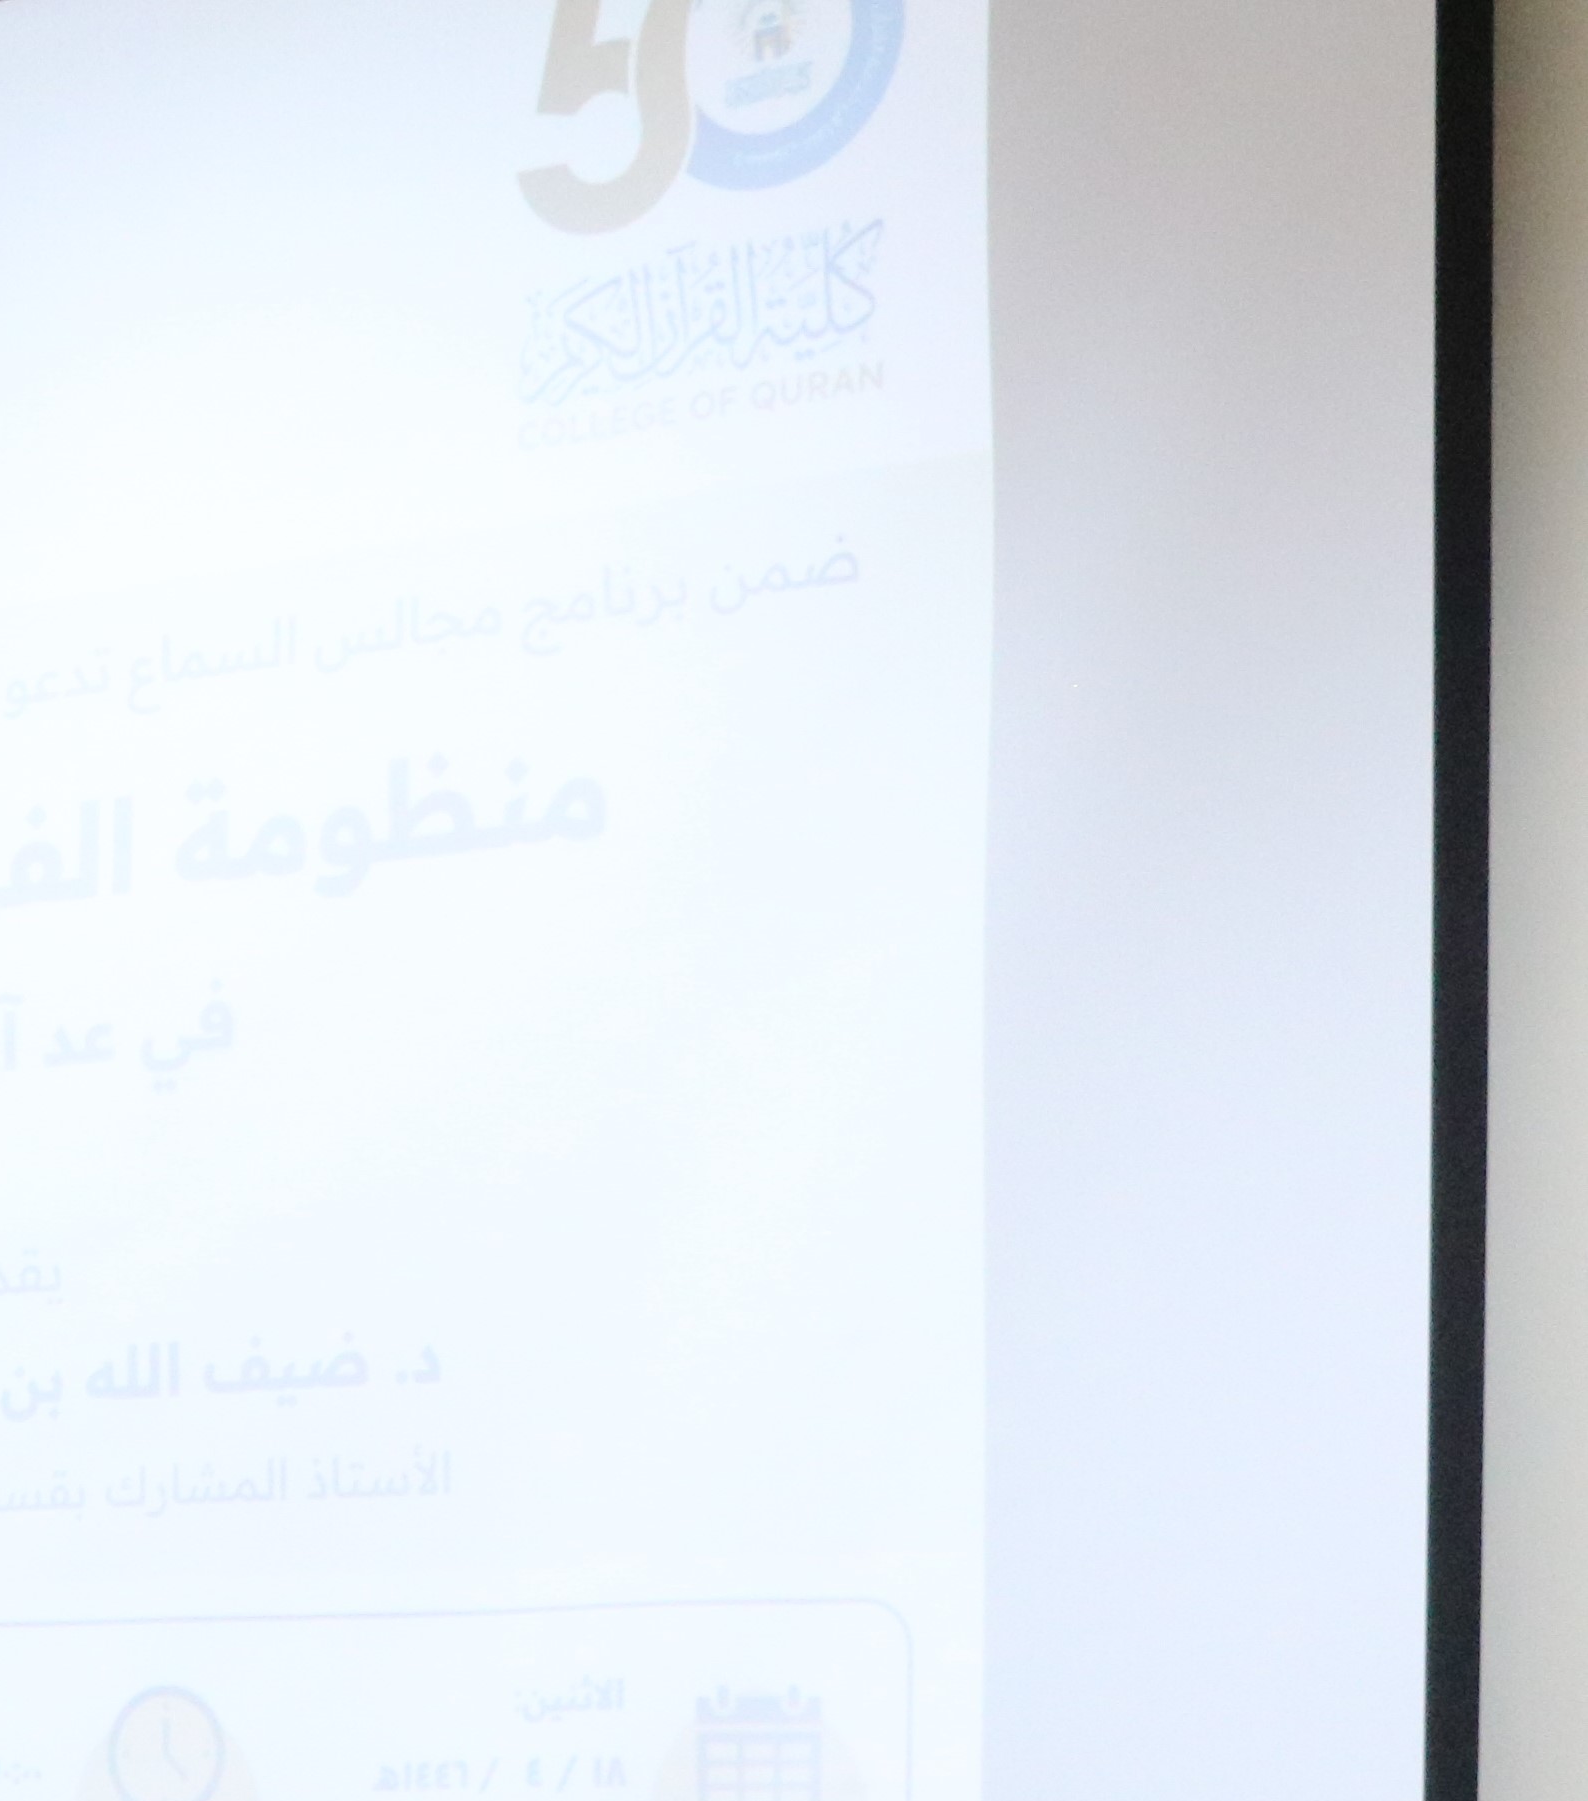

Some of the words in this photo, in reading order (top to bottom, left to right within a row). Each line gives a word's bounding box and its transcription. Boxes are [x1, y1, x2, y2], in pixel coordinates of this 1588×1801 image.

[518, 396, 678, 451] COLLEGE
[689, 385, 738, 420] OF
[750, 361, 885, 410] QURAN
[520, 562, 687, 655] برنامج
[707, 532, 861, 615] ضمن
[126, 616, 298, 714] السماع
[313, 595, 504, 672] مجالس
[2, 648, 112, 720] تدعو
[174, 752, 609, 897] منظومة
[43, 1014, 119, 1067] عد
[139, 981, 238, 1093] في
[86, 1340, 182, 1400] الله
[204, 1330, 369, 1407] ضيف
[394, 1339, 442, 1385] د.
[105, 1456, 288, 1520] المشارك
[306, 1445, 454, 1501] الأستاذ
